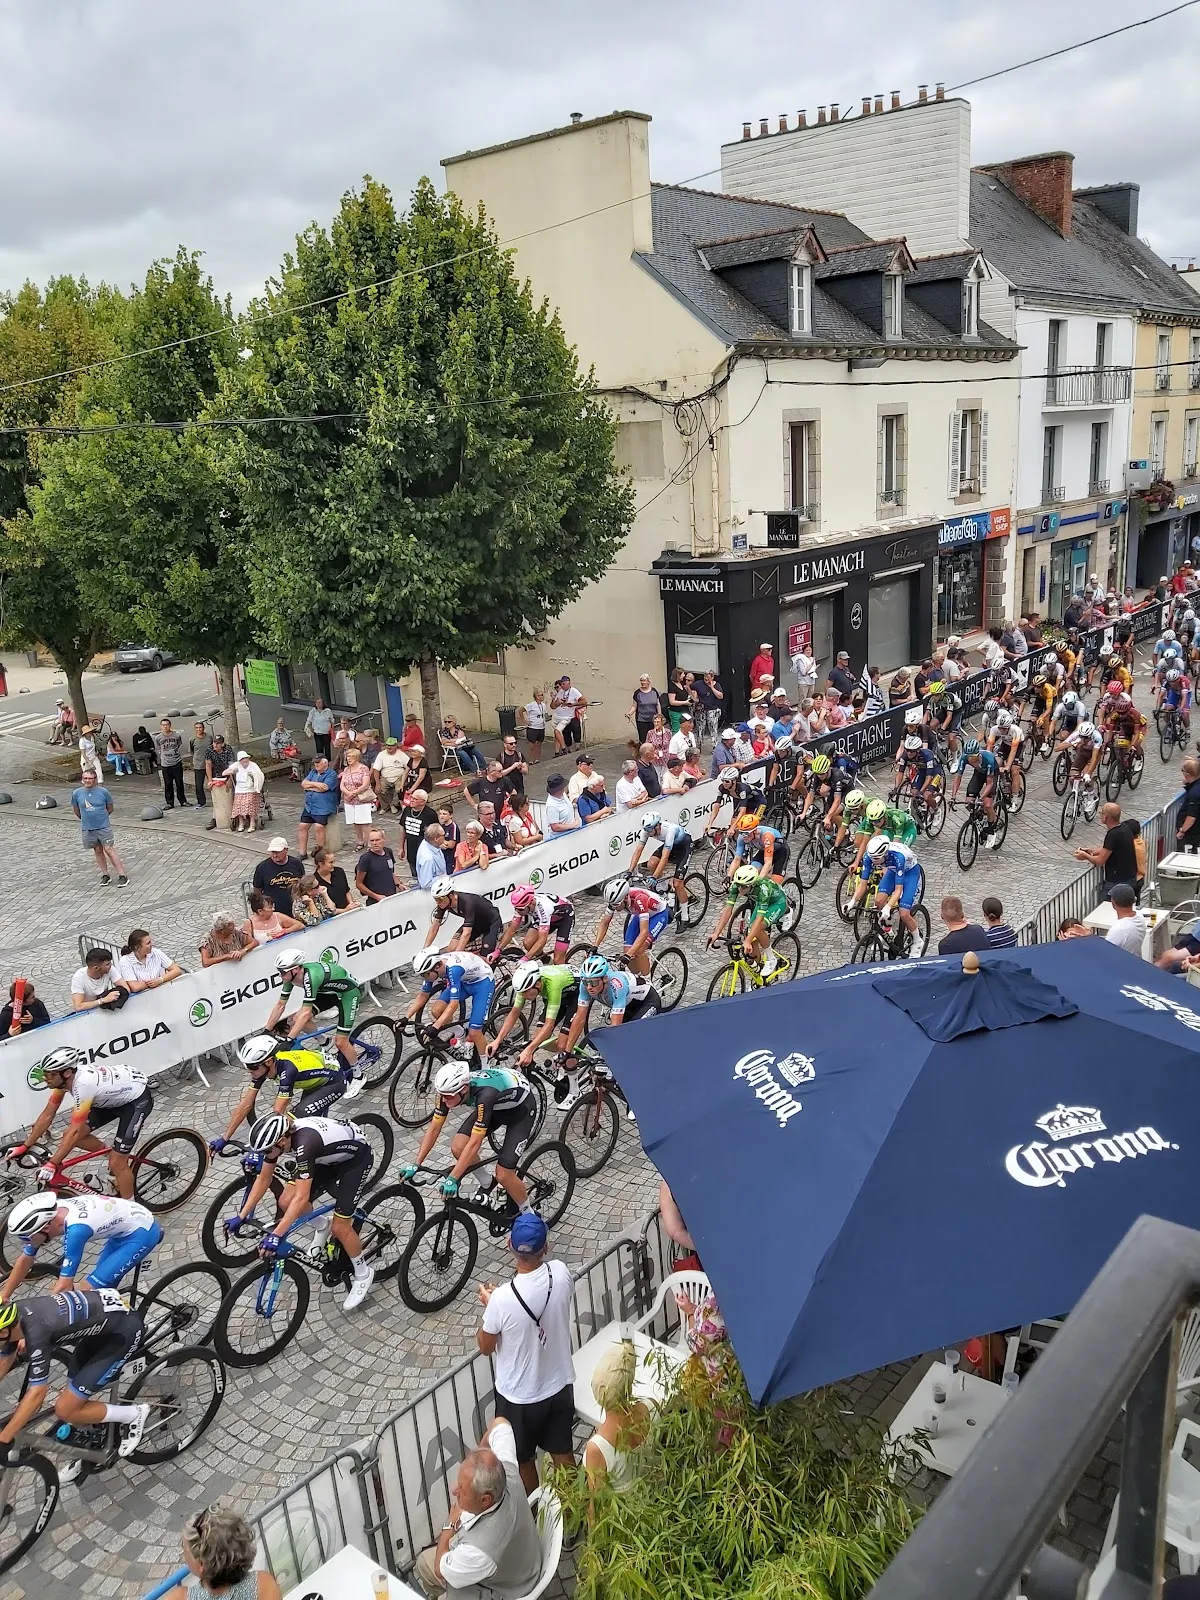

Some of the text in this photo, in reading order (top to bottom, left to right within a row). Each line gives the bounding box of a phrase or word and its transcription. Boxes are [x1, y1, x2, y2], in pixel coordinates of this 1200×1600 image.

[994, 515, 1006, 524] VAPE
[995, 522, 1008, 532] SHOP
[660, 578, 674, 592] LE
[793, 564, 810, 585] LE
[694, 795, 732, 818] ŠKDA
[549, 849, 600, 878] ŠKODA
[480, 883, 516, 901] ODA
[345, 919, 418, 958] ŠKODA
[220, 972, 284, 1010] ŠKOD
[732, 1048, 803, 1125] Corona
[1005, 1124, 1175, 1188] Corona
[113, 1245, 148, 1279] AKKON
[140, 1260, 152, 1273] 143
[132, 1362, 143, 1375] 85
